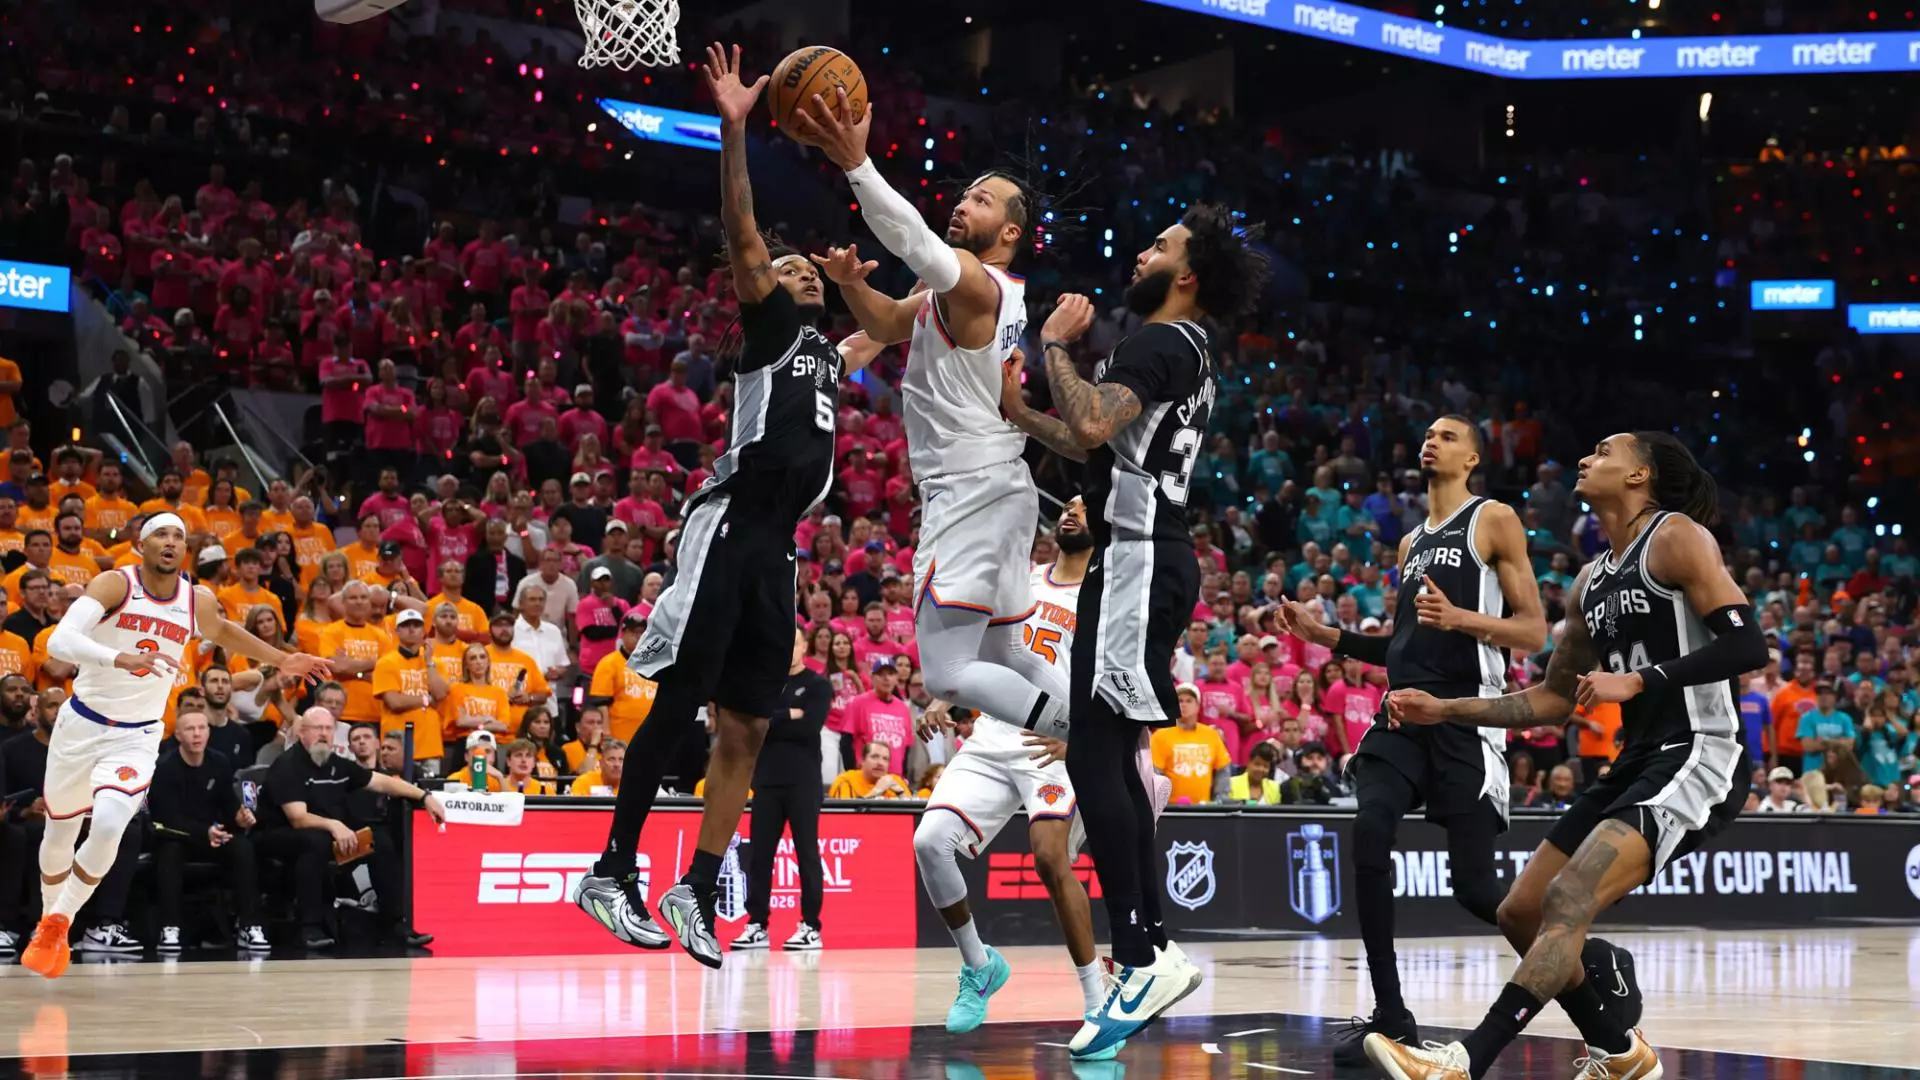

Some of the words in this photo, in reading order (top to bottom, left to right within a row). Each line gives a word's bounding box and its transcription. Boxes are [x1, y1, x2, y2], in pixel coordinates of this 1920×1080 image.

[1294, 4, 1359, 36] meter
[1382, 23, 1444, 55] meter
[1466, 41, 1532, 71] meter
[1562, 44, 1645, 70] meter
[1676, 41, 1761, 68] meter
[1792, 38, 1876, 65] meter
[1763, 284, 1823, 304] meter
[816, 390, 834, 432] 5
[1159, 427, 1203, 507] 3
[1402, 547, 1463, 584] SPURS
[116, 612, 154, 633] NEW
[153, 616, 189, 645] YORK
[1585, 588, 1651, 639] SPURS
[473, 761, 483, 773] G
[445, 800, 505, 814] GATORADE
[829, 838, 859, 854] CUP
[1178, 859, 1206, 895] NHL
[1389, 851, 1454, 897] OME
[1713, 851, 1773, 894] CUP
[1777, 851, 1857, 894] FINAL
[769, 895, 795, 909] 026
